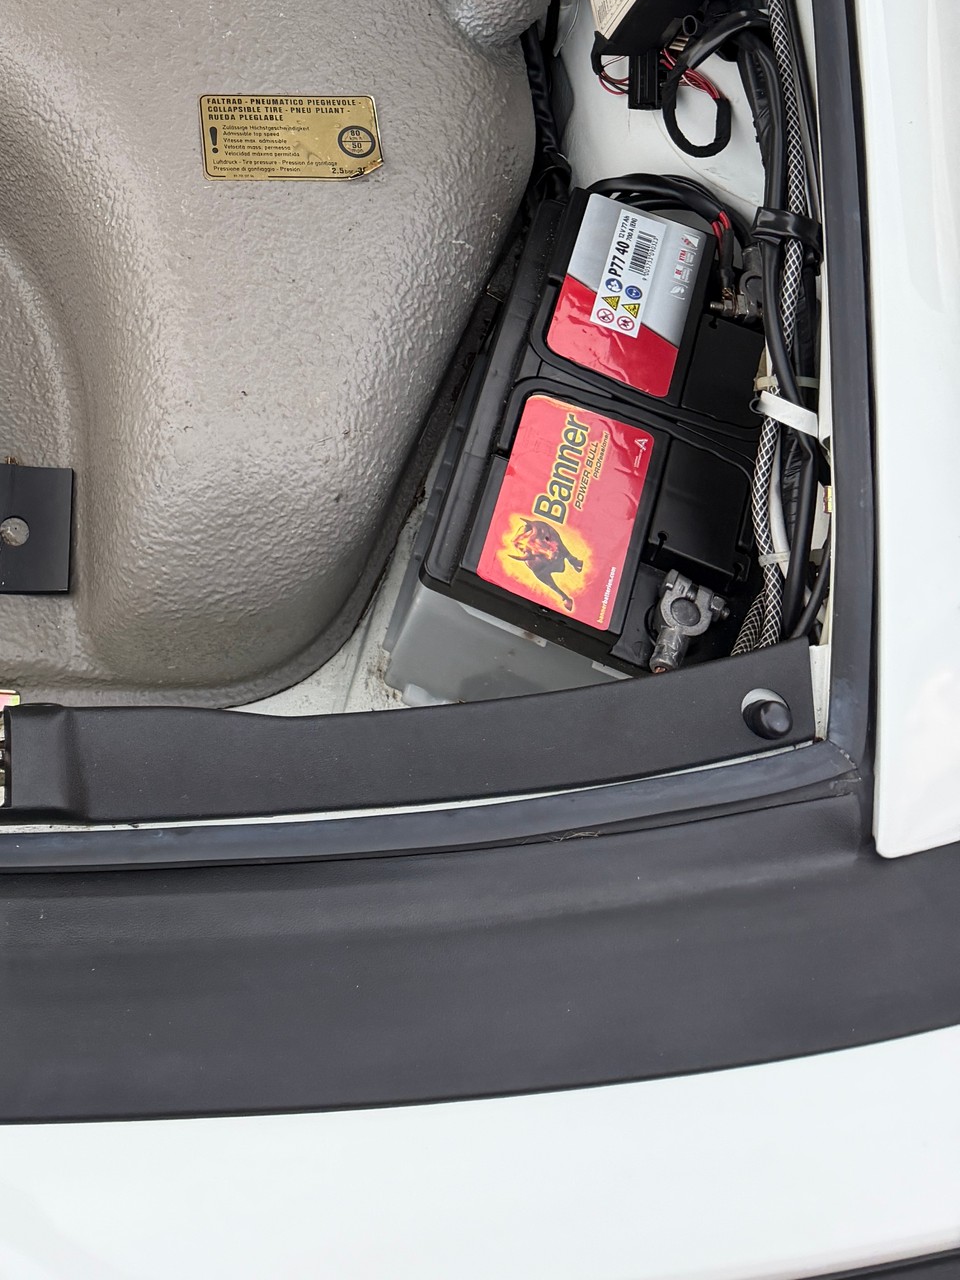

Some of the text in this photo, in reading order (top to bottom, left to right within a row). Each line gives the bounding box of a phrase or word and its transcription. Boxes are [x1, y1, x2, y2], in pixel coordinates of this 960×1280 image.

[608, 241, 630, 278] P77 40
[626, 232, 634, 242] 700
[533, 413, 589, 525] Banner
[574, 441, 598, 510] POWER BULL
[597, 566, 617, 624] bannerbatterien.com
